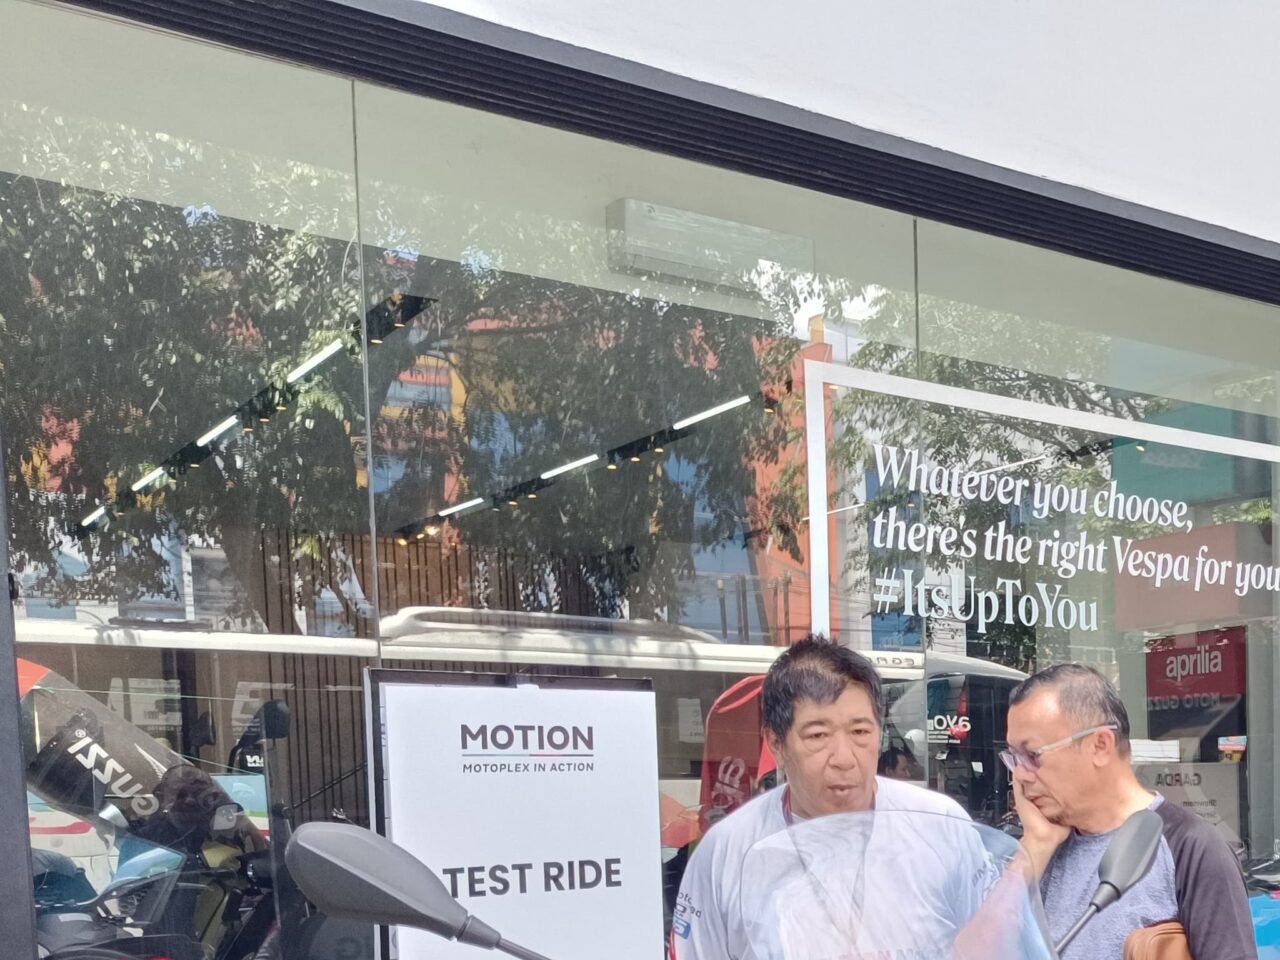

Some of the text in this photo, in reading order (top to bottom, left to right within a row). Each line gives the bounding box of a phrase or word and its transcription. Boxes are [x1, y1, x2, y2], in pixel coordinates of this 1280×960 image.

[872, 443, 1194, 534] Whatever you choose,
[872, 510, 977, 558] there's
[984, 531, 1033, 567] the
[1037, 534, 1107, 579] right
[1113, 534, 1190, 587] Vespa
[1193, 545, 1234, 592] for
[873, 566, 1098, 634] #ItsUpToYou
[1166, 645, 1222, 682] aprilia
[460, 724, 594, 750] MOTION
[462, 762, 594, 773] MOTOPLEX IN ACTION
[442, 858, 622, 898] TEST RIDE
